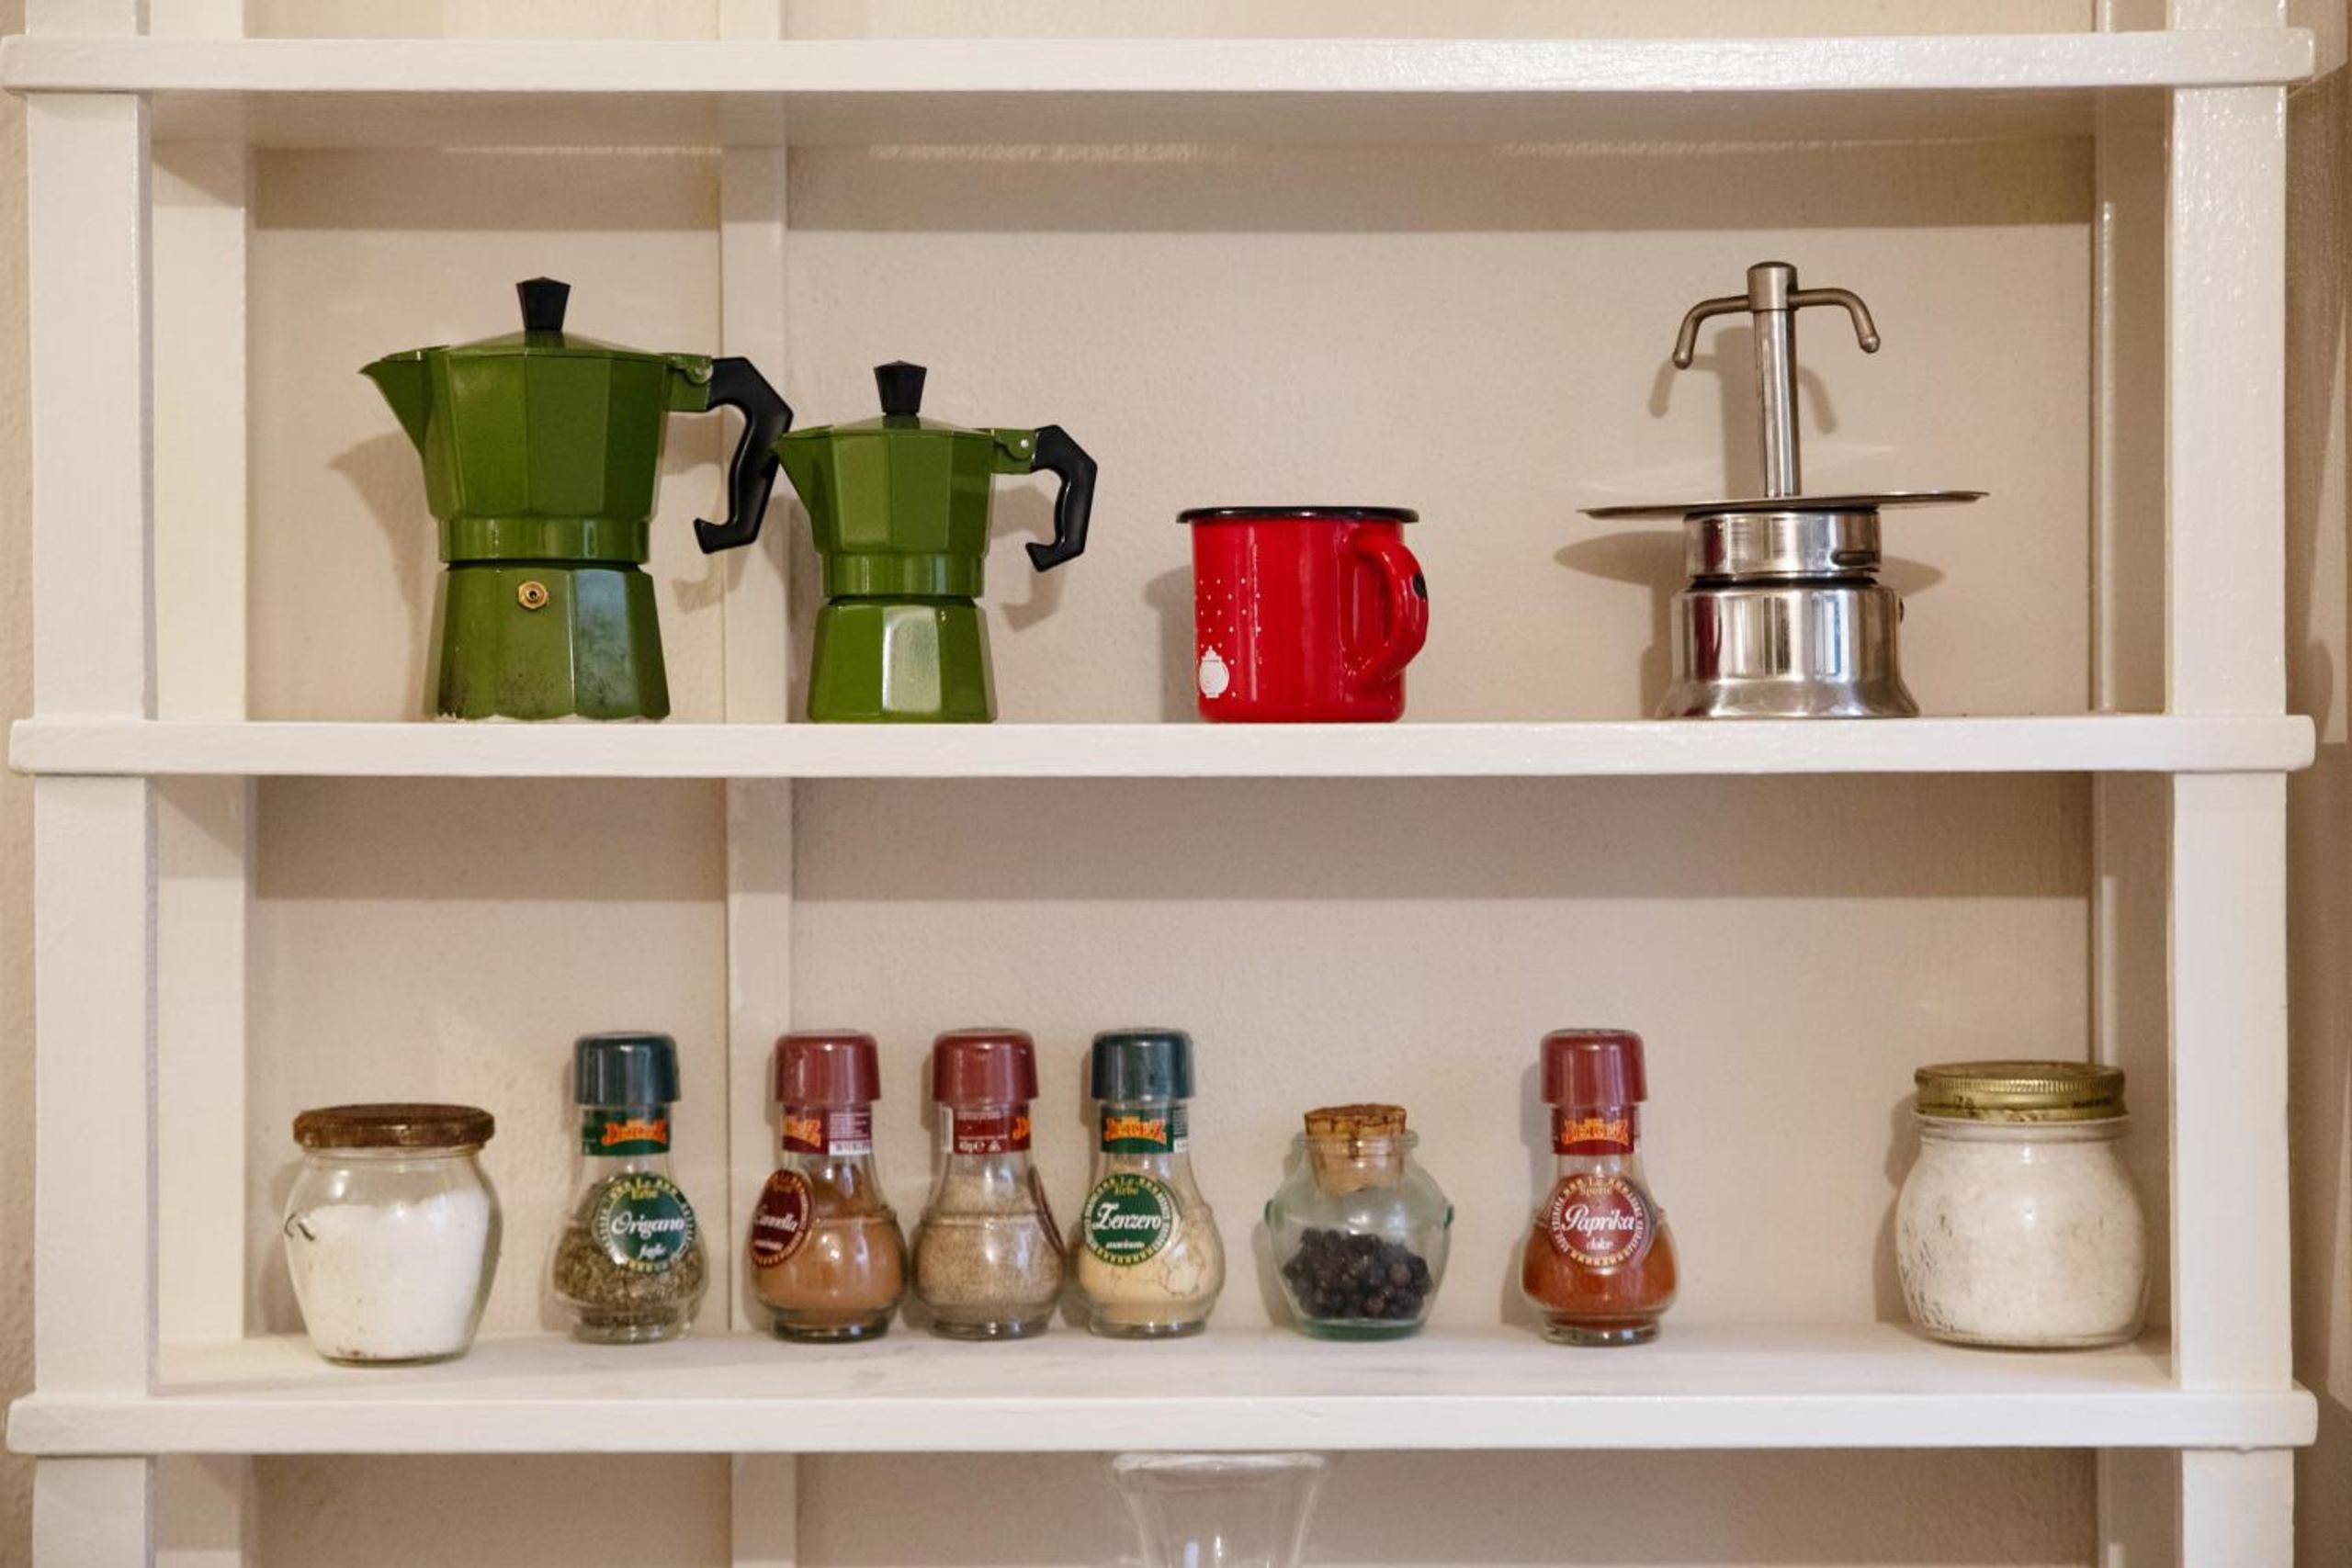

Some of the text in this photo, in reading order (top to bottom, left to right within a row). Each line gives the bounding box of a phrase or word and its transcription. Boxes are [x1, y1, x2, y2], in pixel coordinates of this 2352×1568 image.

[611, 1211, 685, 1240] Origano
[1092, 1201, 1162, 1230] Zenzero
[1563, 1203, 1635, 1237] Paprika
